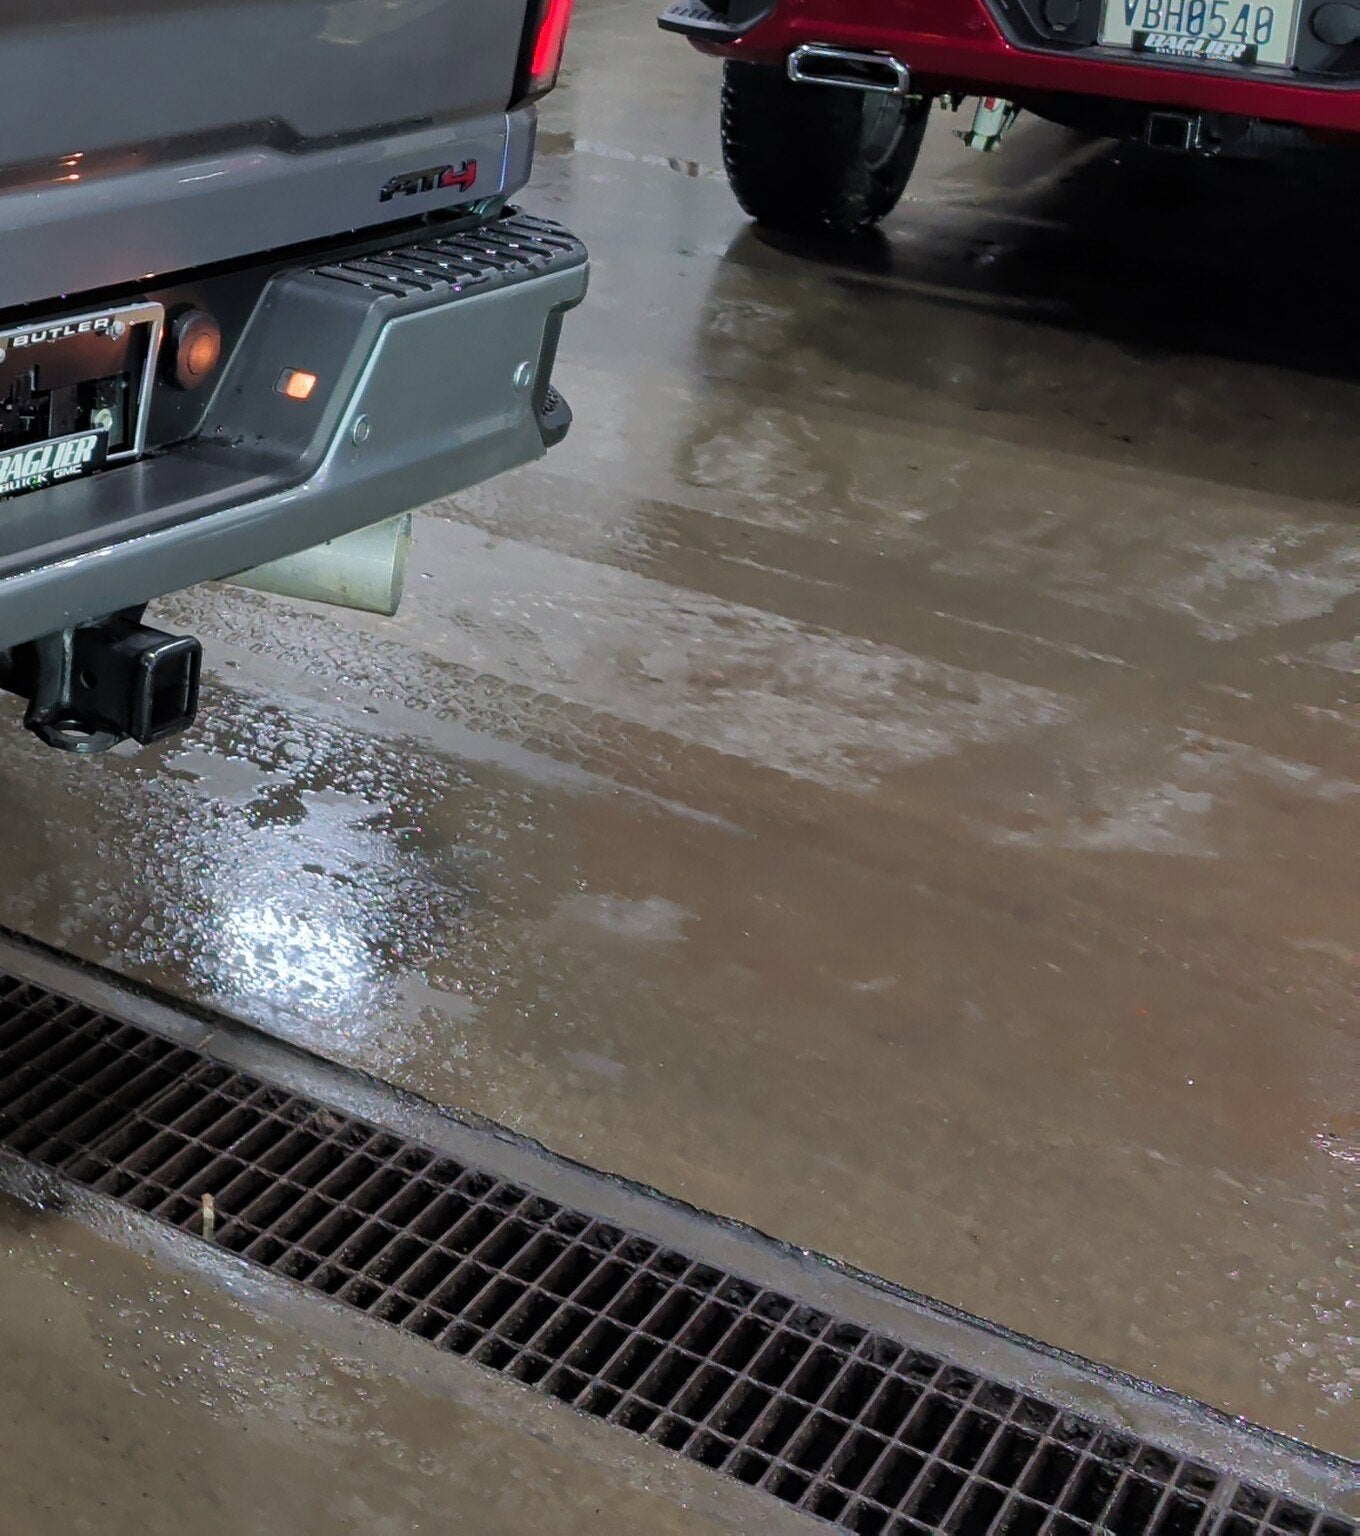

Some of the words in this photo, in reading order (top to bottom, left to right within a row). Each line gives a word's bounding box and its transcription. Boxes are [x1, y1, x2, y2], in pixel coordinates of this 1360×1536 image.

[1144, 33, 1247, 58] BAGLIER
[379, 159, 477, 203] AT4
[13, 318, 109, 347] BUTLER
[0, 473, 48, 494] BUICK
[53, 464, 82, 478] GMC
